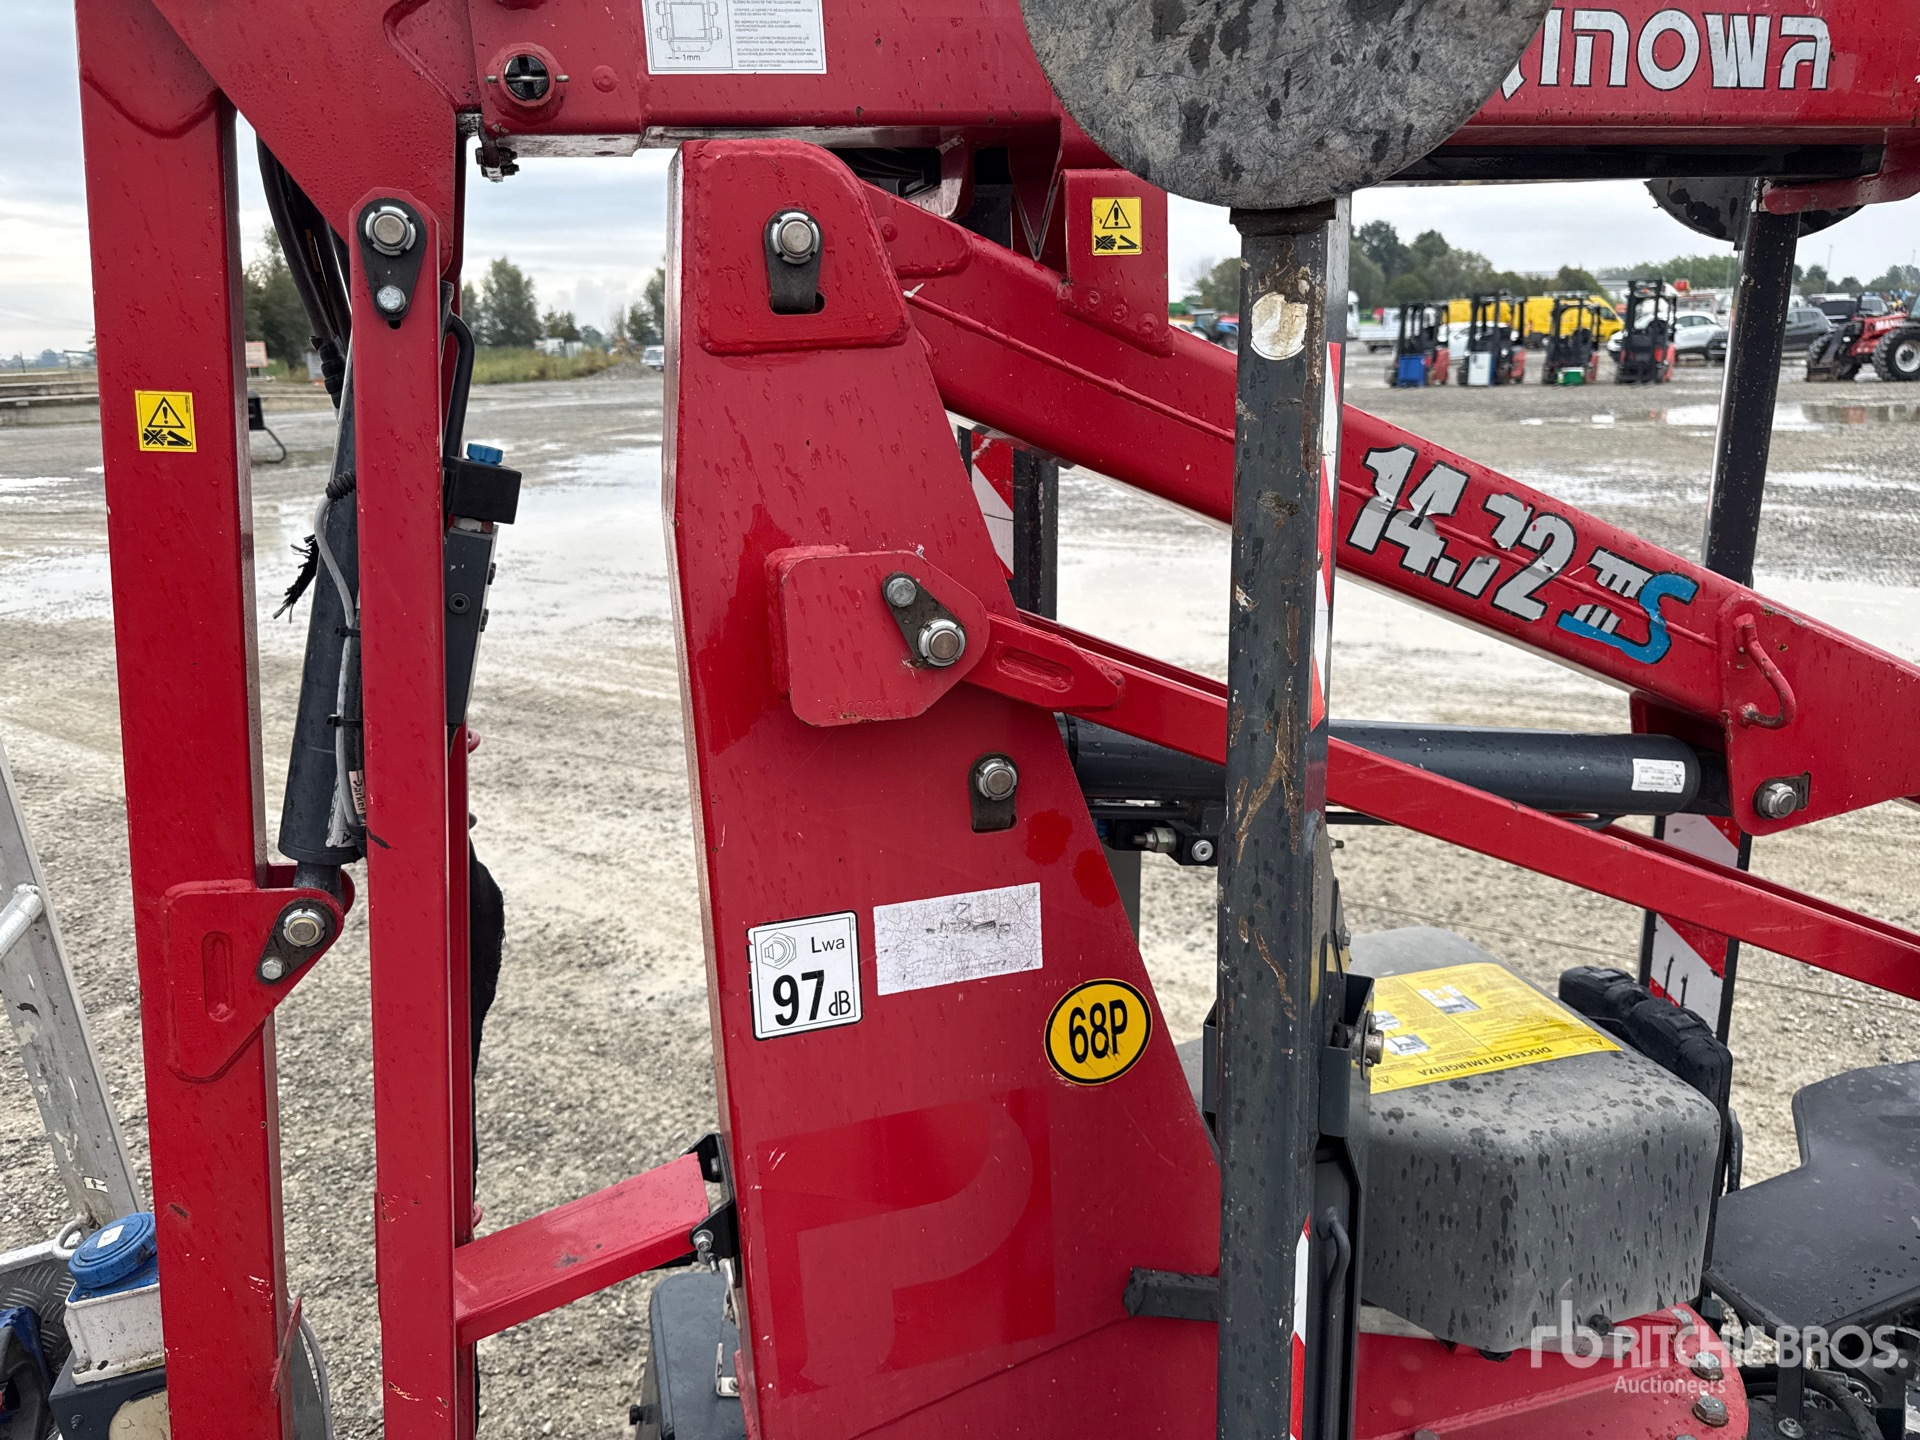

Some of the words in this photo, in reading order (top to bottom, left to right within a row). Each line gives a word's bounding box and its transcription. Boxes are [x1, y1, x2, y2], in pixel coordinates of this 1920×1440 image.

[682, 53, 701, 61] 1mm
[1345, 442, 1577, 622] 14.72
[772, 969, 826, 1027] 97
[828, 990, 851, 1017] dB
[1068, 998, 1129, 1065] 68P
[1490, 1056, 1504, 1064] DI
[1505, 1046, 1553, 1061] DISCESA
[1416, 1058, 1491, 1077] EMERGENZA
